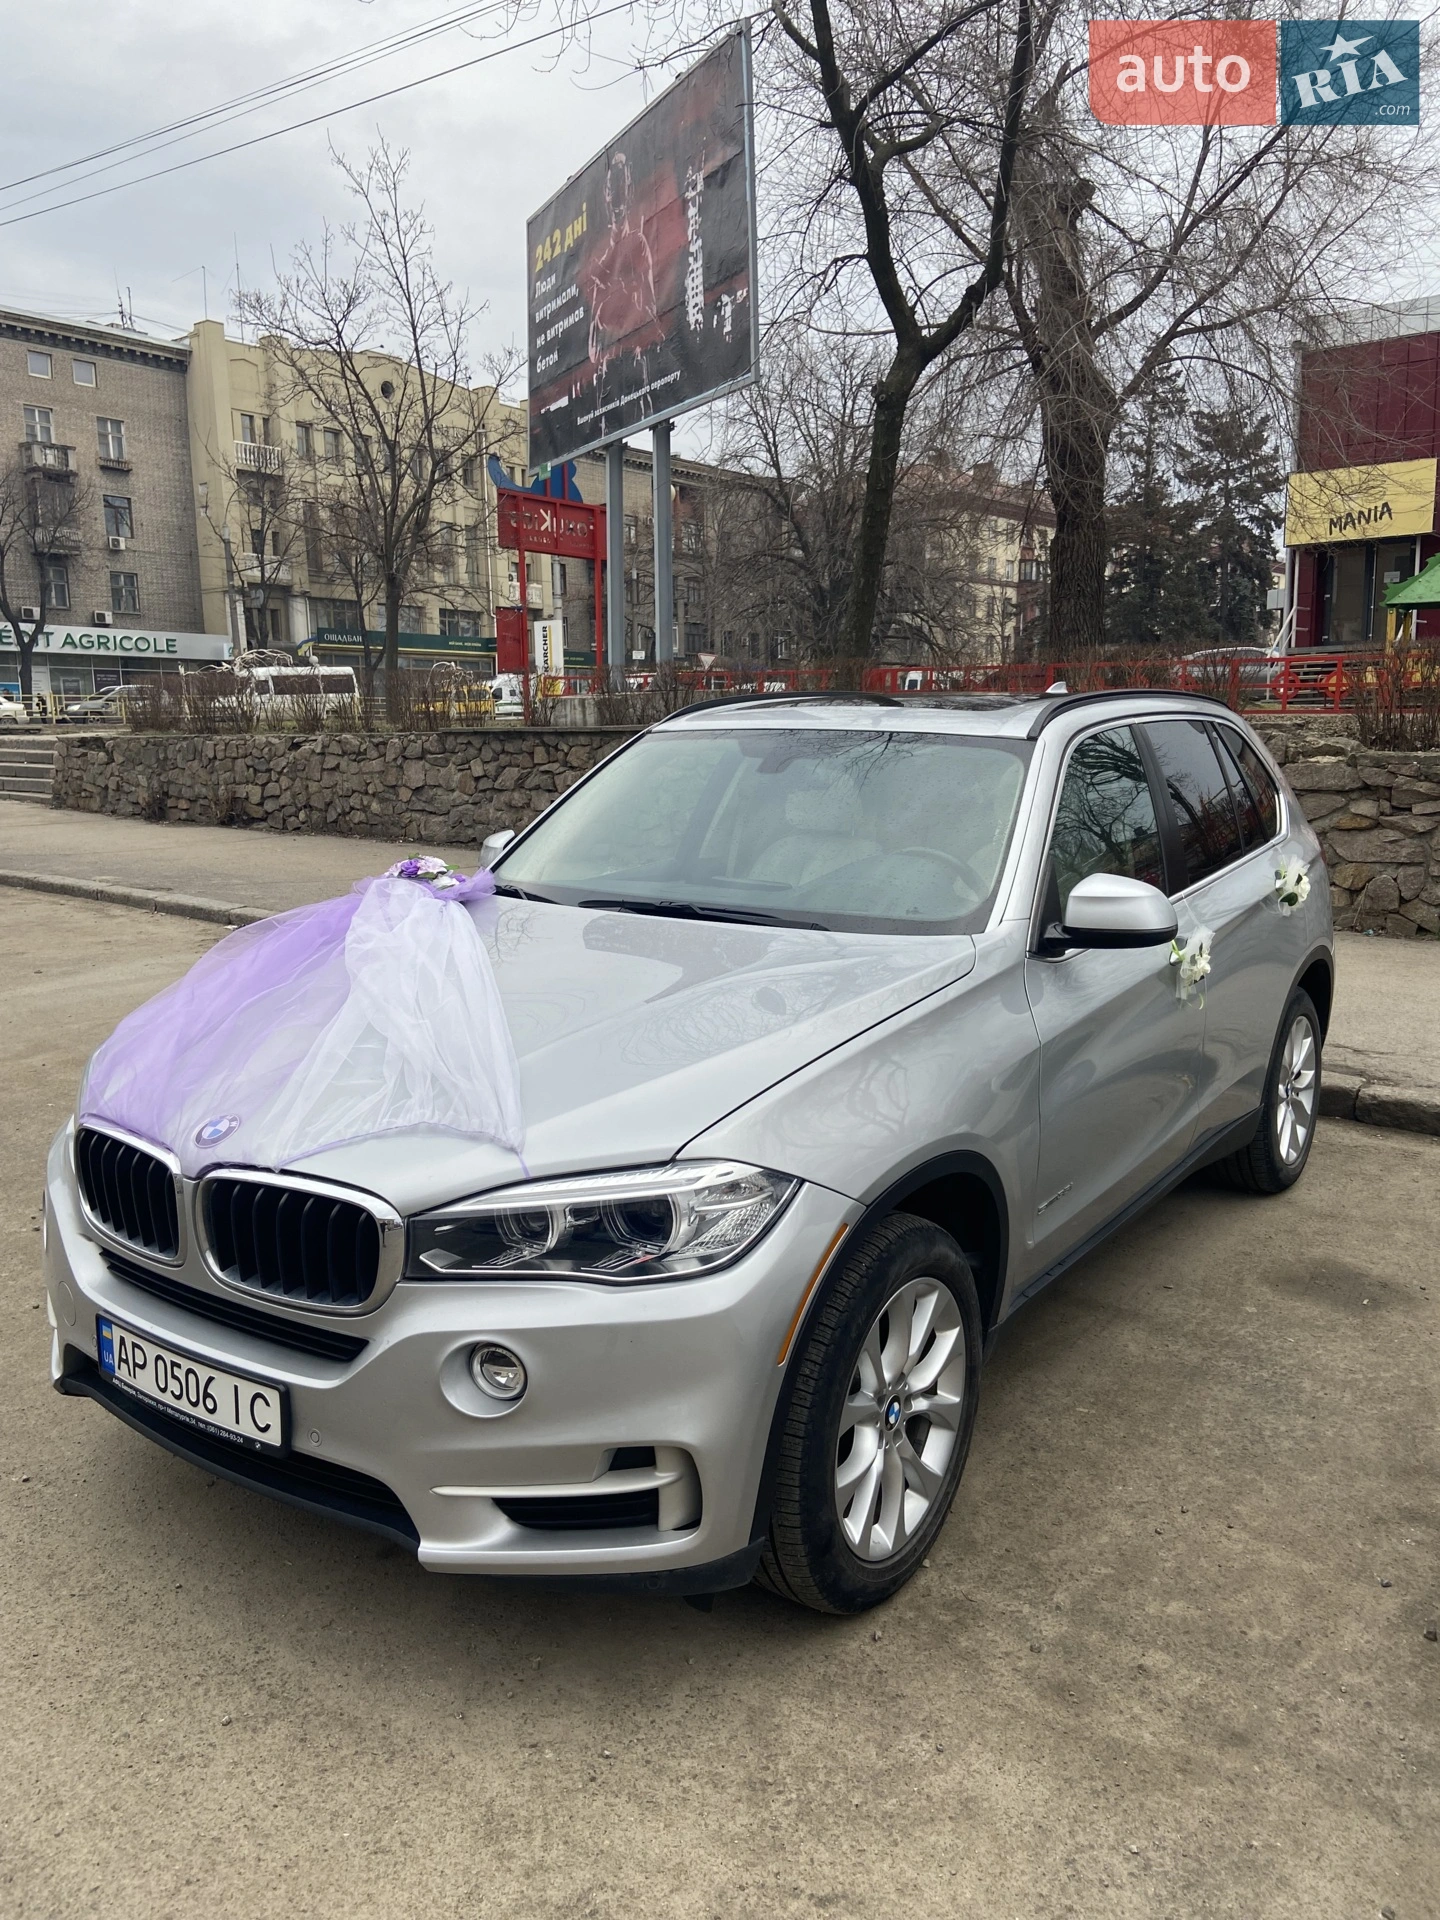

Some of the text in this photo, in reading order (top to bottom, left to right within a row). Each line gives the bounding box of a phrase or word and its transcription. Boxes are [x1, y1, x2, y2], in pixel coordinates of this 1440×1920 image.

[535, 229, 561, 273] 242
[535, 273, 556, 299] Люди
[535, 283, 579, 323] витримали,
[536, 306, 585, 349] не витримав
[536, 350, 559, 373] бетон
[651, 369, 681, 391] аеропорту
[1329, 501, 1393, 536] MANIA
[60, 633, 178, 653] AGRICOLE
[324, 633, 363, 643] ОЩАДБАН
[104, 1335, 272, 1434] UA AP 0506 IC
